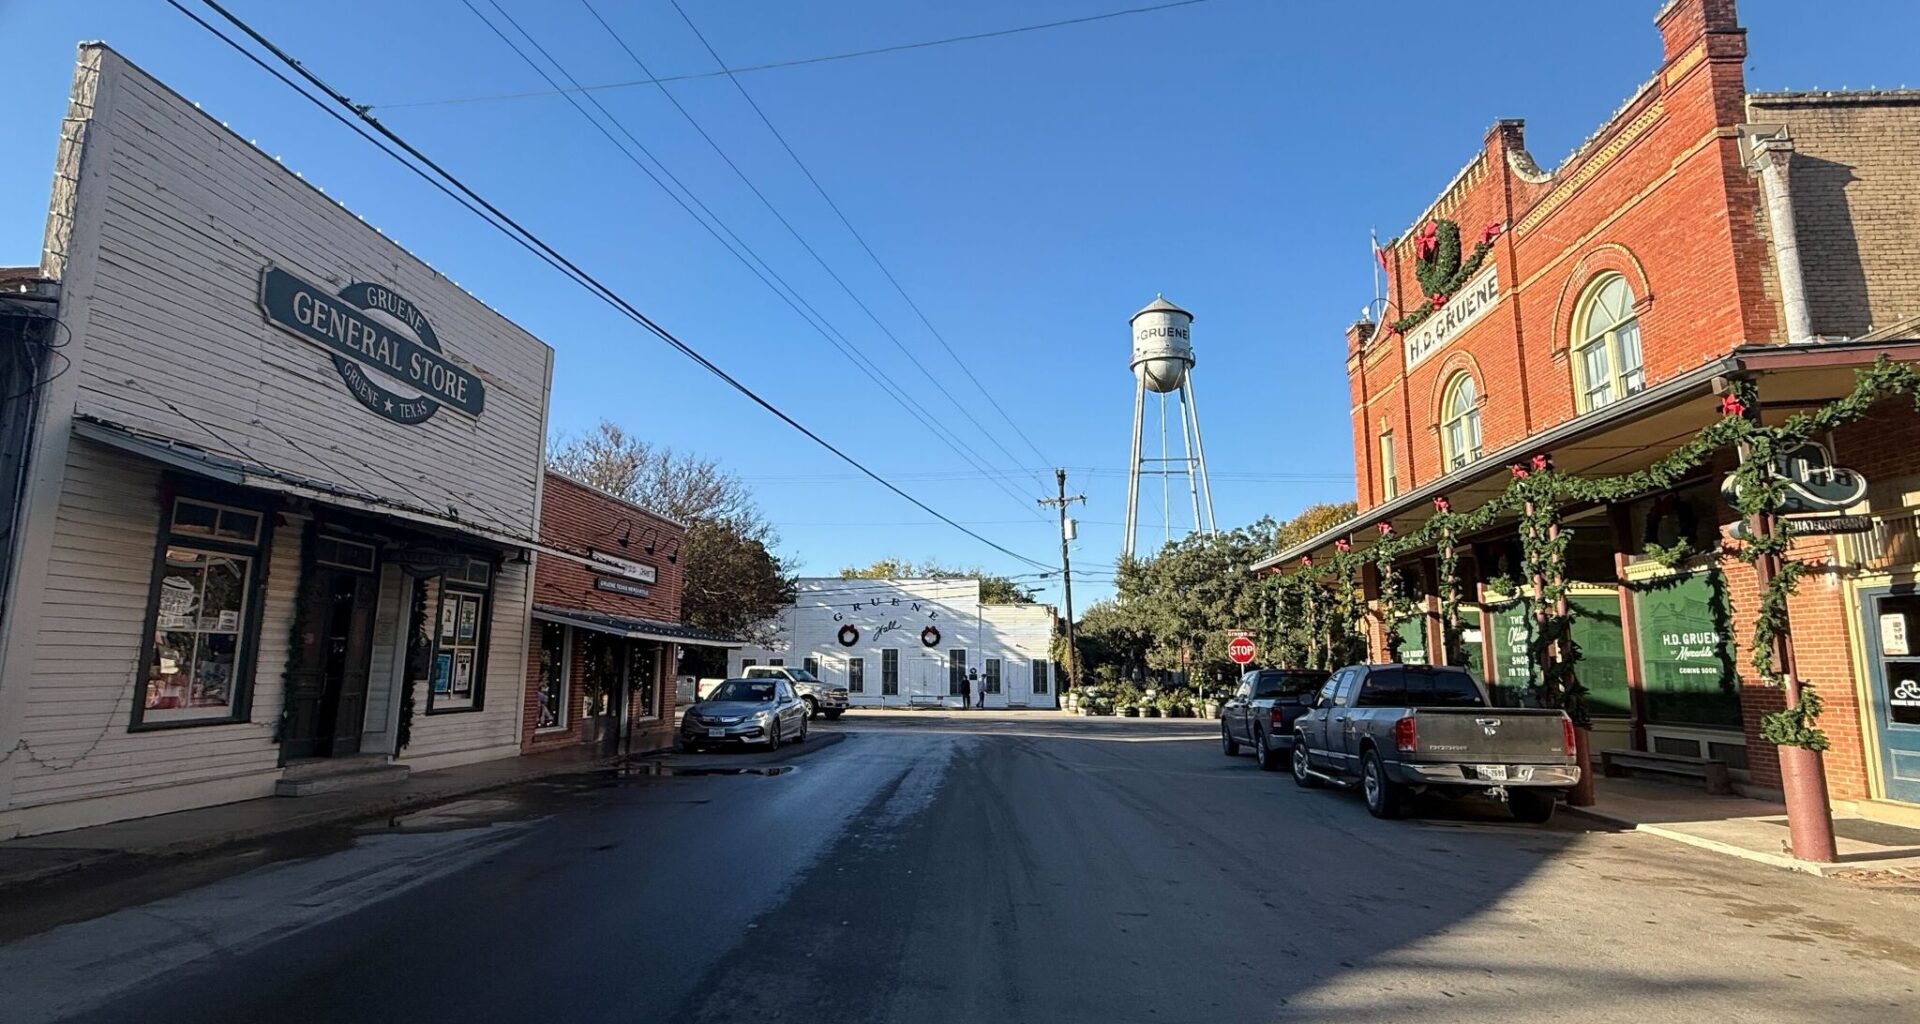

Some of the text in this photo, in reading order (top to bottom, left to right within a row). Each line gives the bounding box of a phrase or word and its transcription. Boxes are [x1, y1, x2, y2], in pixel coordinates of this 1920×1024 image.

[366, 286, 424, 334] GRUENE
[1410, 274, 1498, 362] H.D. GRUENE
[1140, 326, 1189, 340] GRUENE
[293, 291, 468, 404] GENERAL STORE
[344, 362, 427, 418] GRUENE TEXAS
[833, 598, 939, 621] GRUENE
[1510, 615, 1524, 625] THE
[873, 620, 902, 641] Hall
[1663, 631, 1726, 646] H.D. GRUENE
[1230, 645, 1253, 656] STOP
[1511, 655, 1529, 665] SHOP
